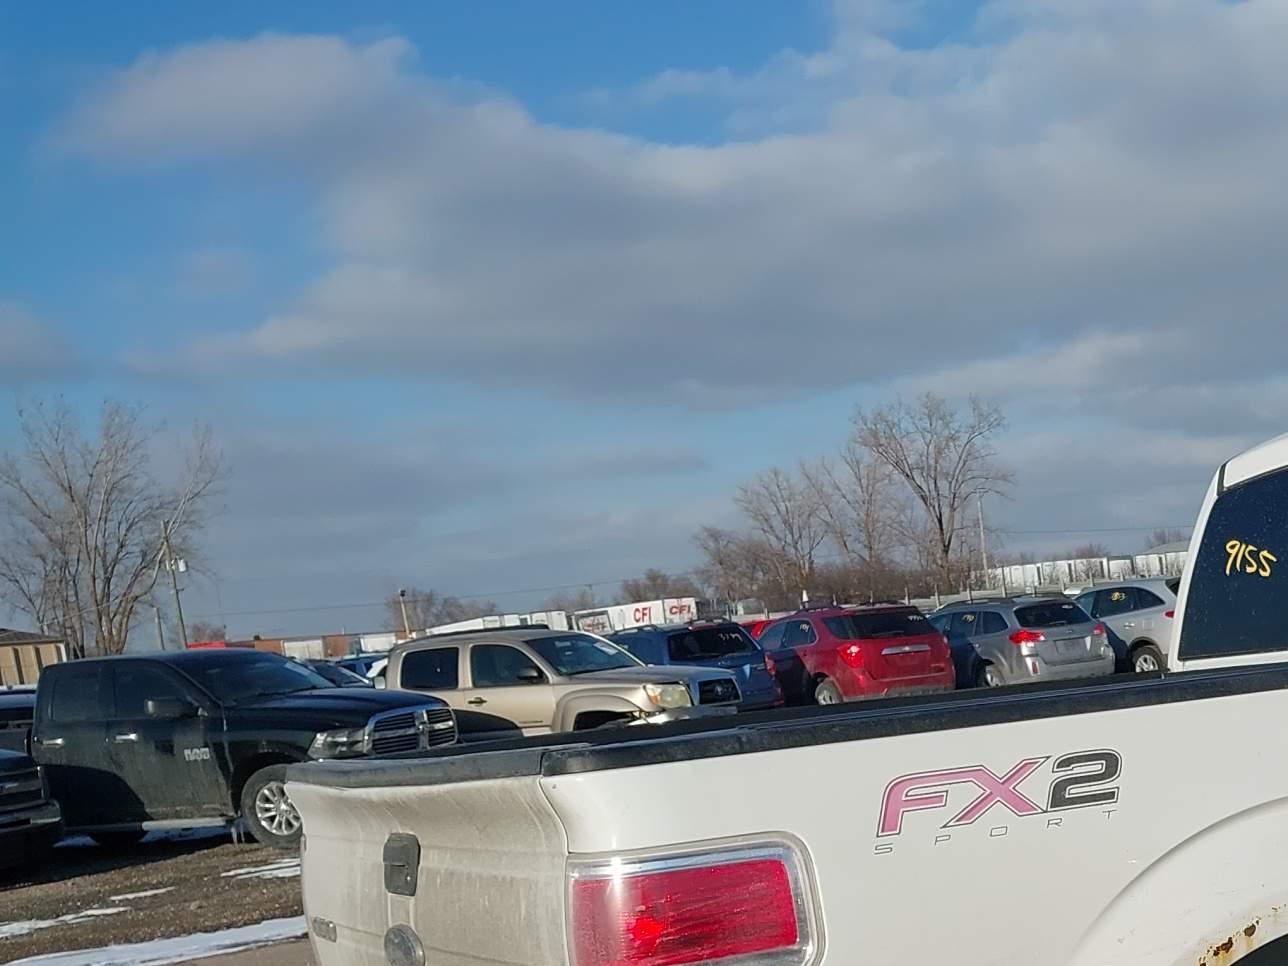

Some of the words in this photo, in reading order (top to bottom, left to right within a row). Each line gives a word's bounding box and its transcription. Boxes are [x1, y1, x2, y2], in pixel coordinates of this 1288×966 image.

[1226, 540, 1277, 576] 9155
[633, 606, 652, 623] CFI
[669, 605, 691, 615] CFI
[876, 748, 1123, 838] FX2
[873, 810, 1117, 855] SPORT
